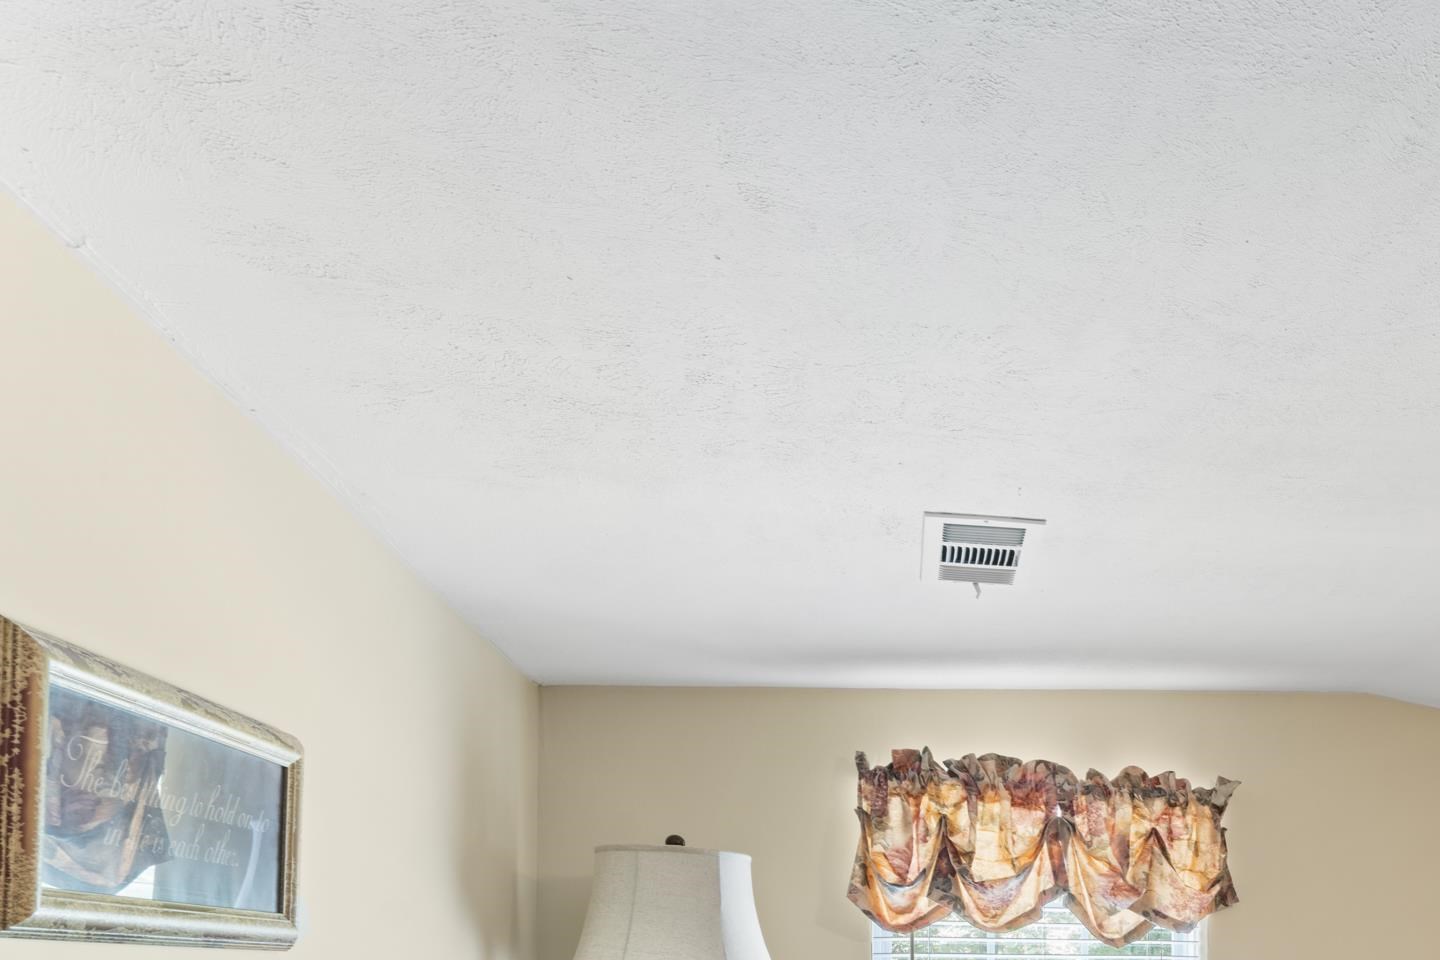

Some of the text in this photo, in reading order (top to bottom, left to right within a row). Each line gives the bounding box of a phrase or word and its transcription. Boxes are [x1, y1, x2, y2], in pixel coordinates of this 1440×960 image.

[60, 735, 109, 797] The
[204, 784, 241, 825] hold
[169, 823, 206, 860] each
